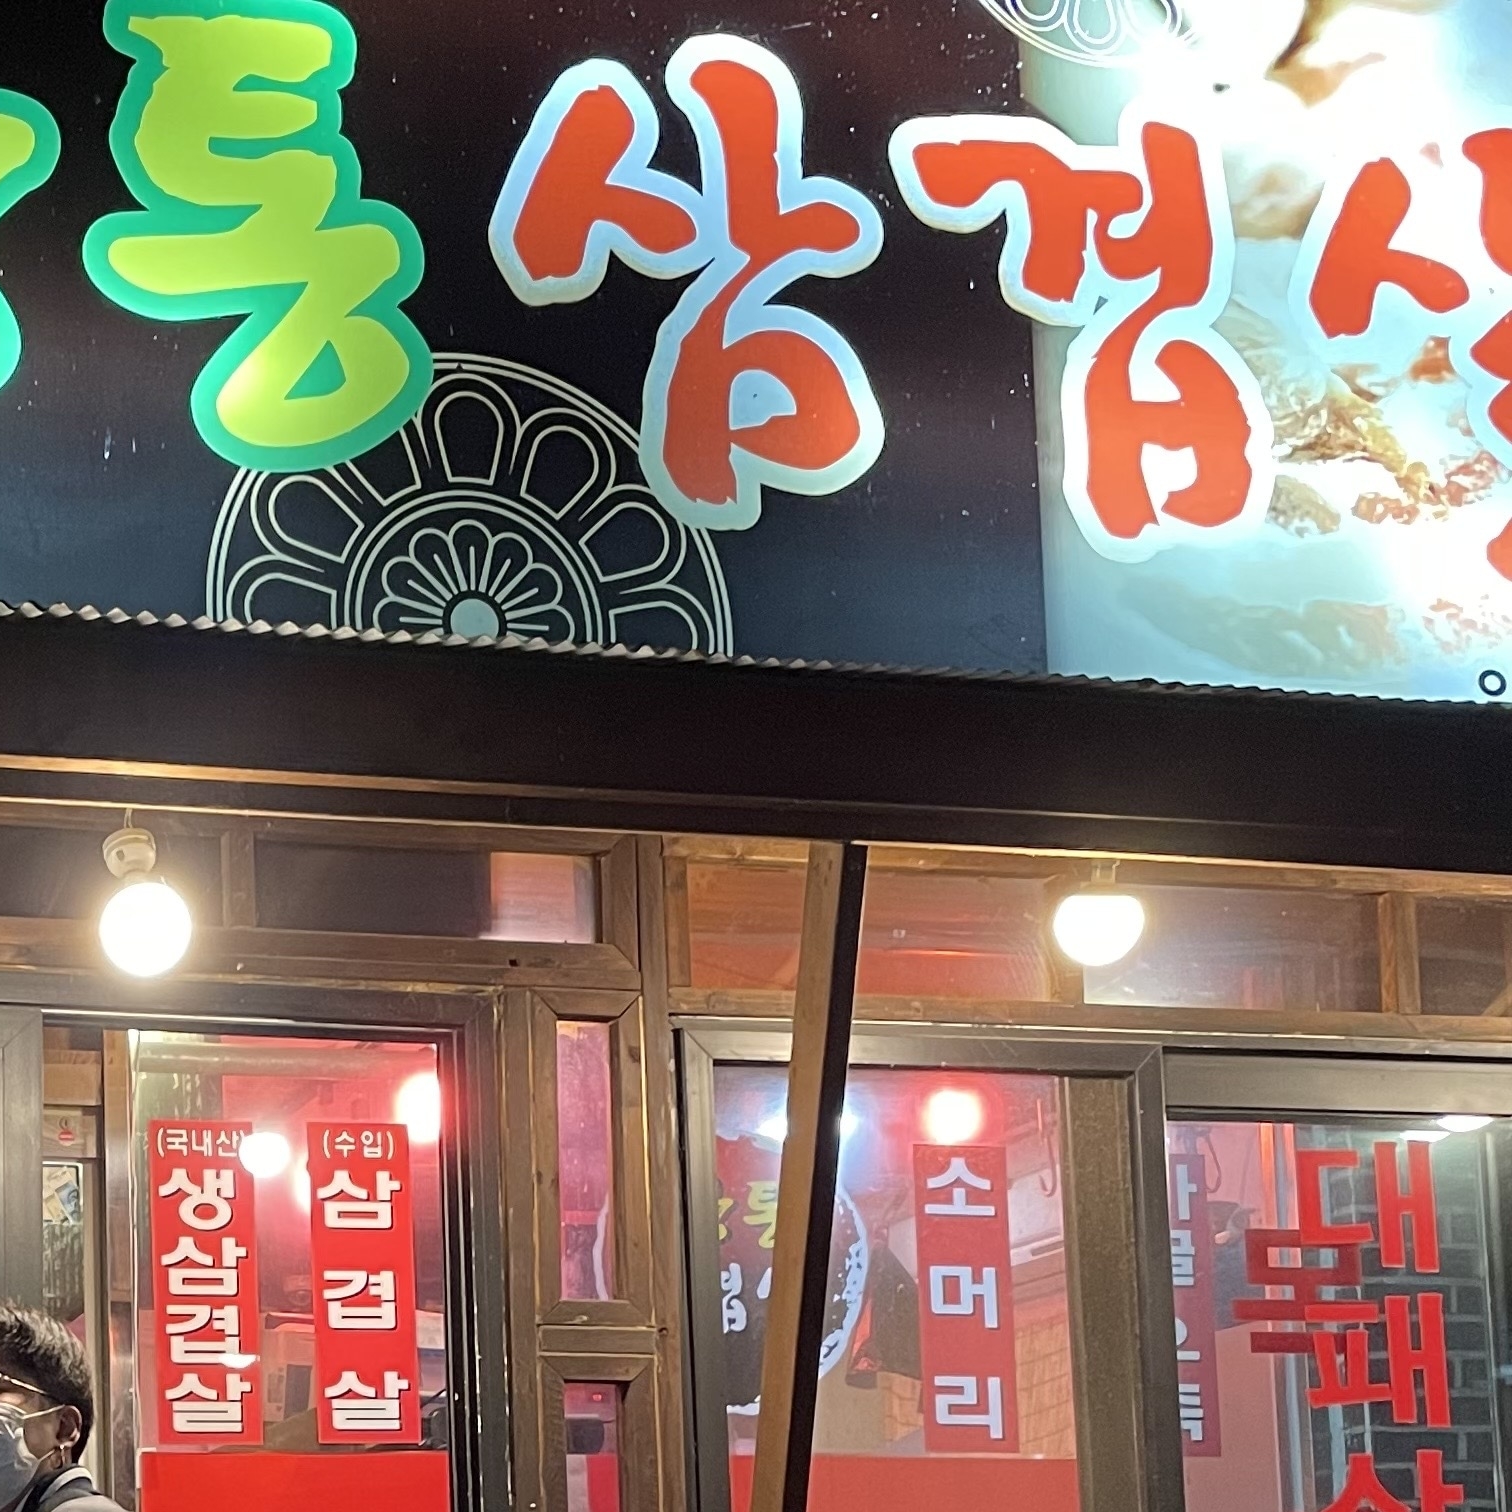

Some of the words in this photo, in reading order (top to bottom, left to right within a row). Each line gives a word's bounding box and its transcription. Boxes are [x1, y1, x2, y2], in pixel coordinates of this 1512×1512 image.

[322, 1129, 394, 1160] (수입)
[158, 1168, 253, 1433] 생삼겹살
[316, 1169, 409, 1431] 삼겹살
[924, 1156, 1005, 1440] 소머리
